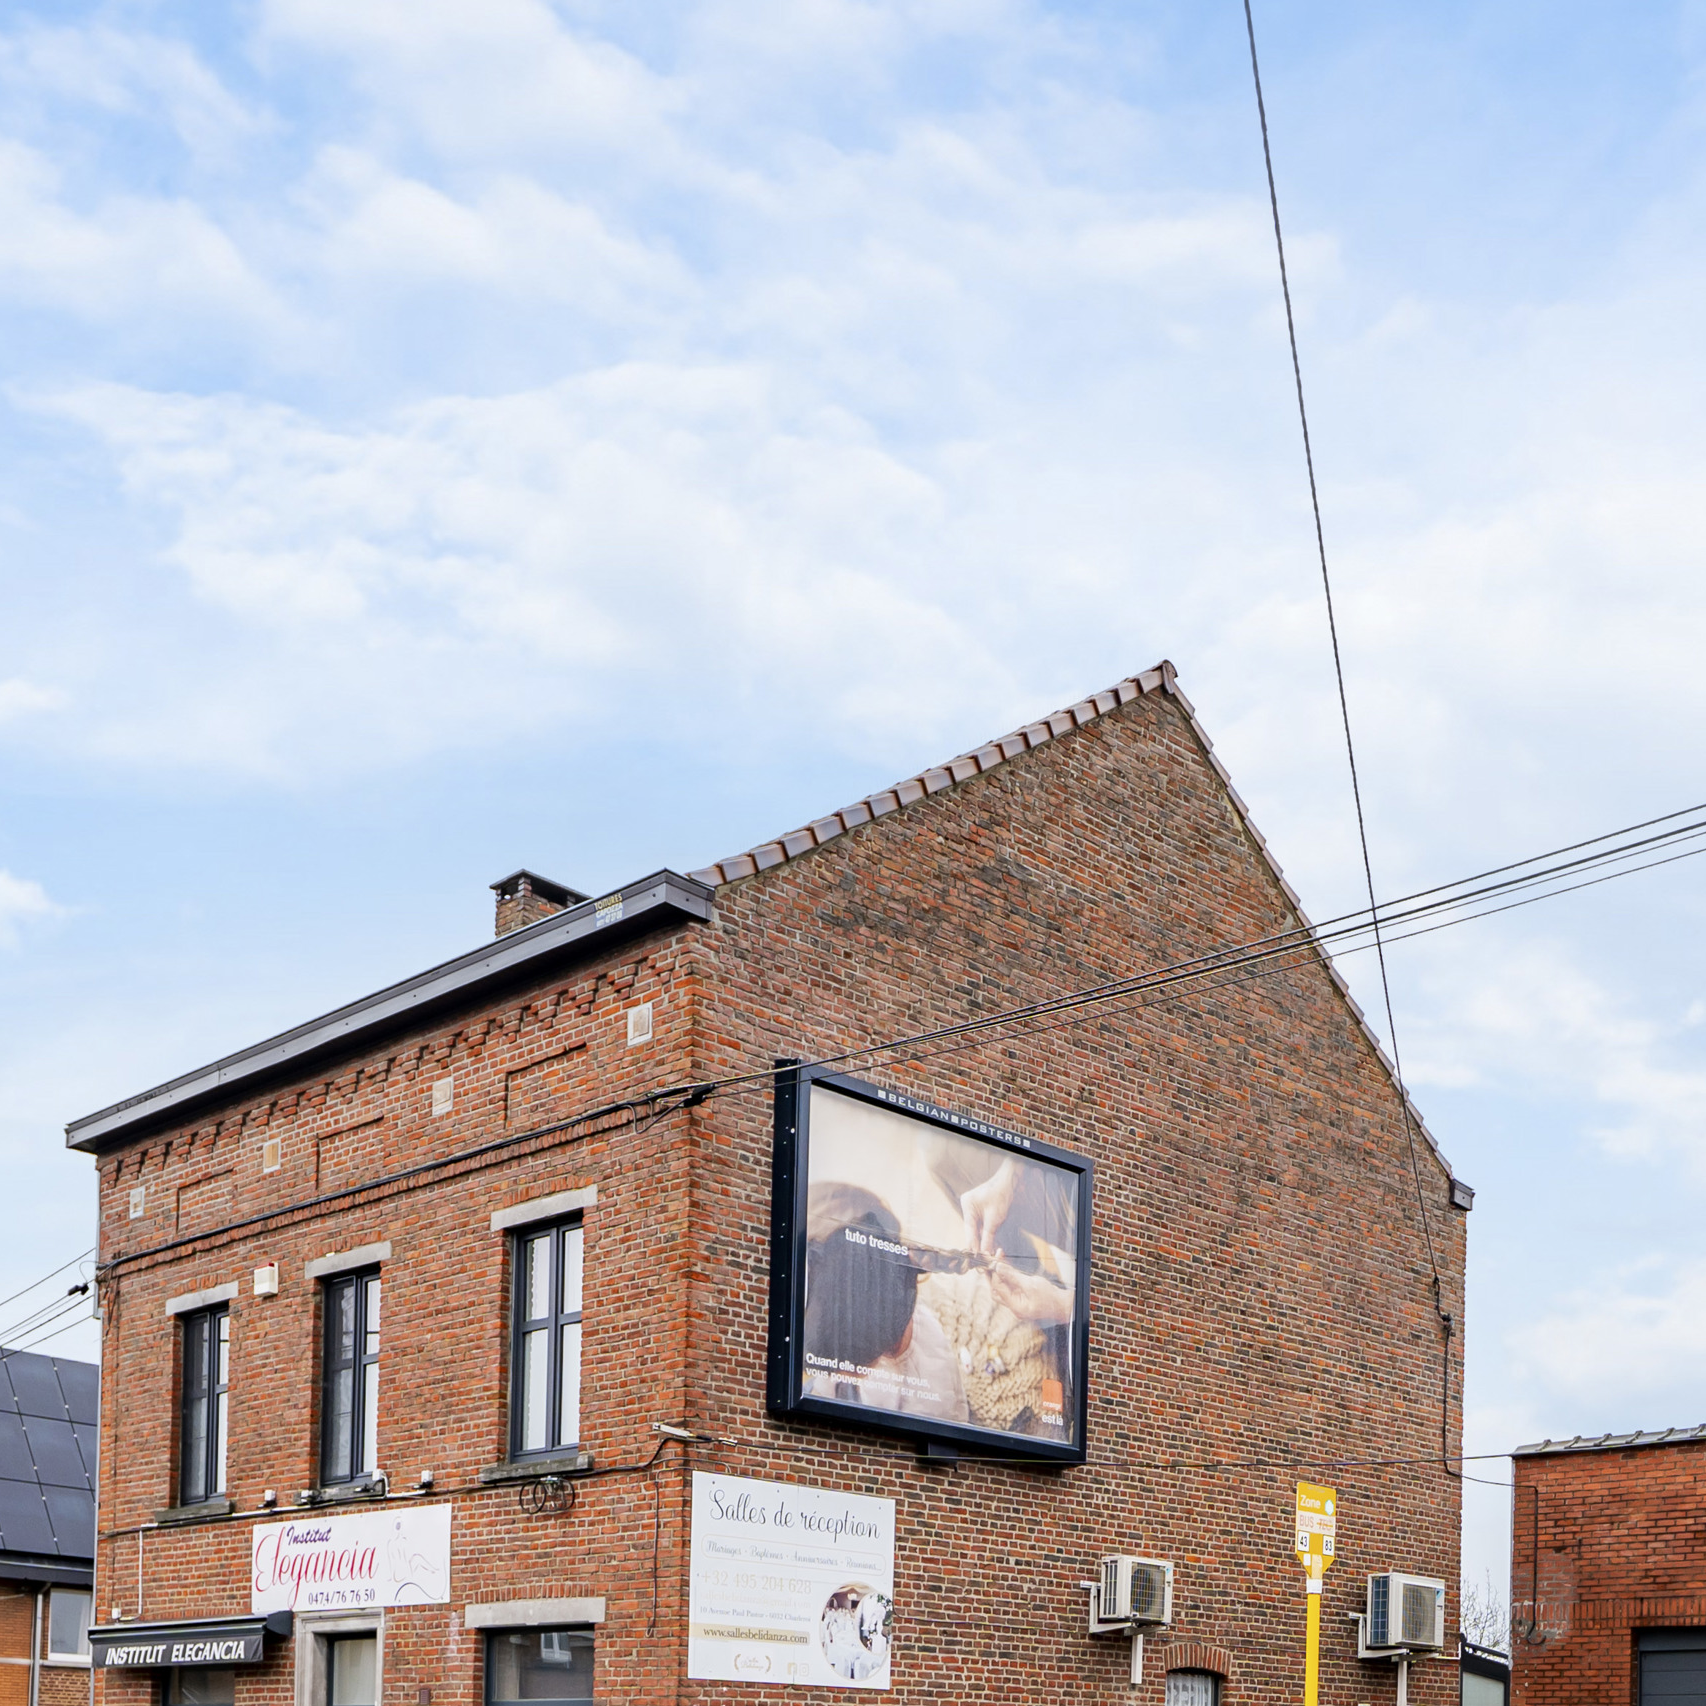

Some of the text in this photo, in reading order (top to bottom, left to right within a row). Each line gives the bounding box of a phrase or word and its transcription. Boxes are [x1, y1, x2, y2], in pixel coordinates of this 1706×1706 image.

[888, 1093, 1022, 1146] BELGIAN POSTERS
[845, 1228, 909, 1256] tuto tresses
[805, 1353, 838, 1369] Quand
[839, 1360, 855, 1372] elle
[856, 1365, 891, 1379] compte
[892, 1373, 904, 1383] sur
[806, 1368, 829, 1379] vous
[830, 1373, 861, 1387] pouvez
[901, 1386, 915, 1397] sur
[1042, 1414, 1055, 1424] est
[1300, 1495, 1321, 1509] Zone
[709, 1489, 881, 1543] Salles de réception
[1299, 1514, 1314, 1528] BUS
[286, 1526, 333, 1546] Institut
[1299, 1536, 1308, 1548] 43
[1325, 1540, 1333, 1551] 83
[707, 1541, 741, 1557] Mariages
[255, 1526, 380, 1611] Elegancia
[701, 1570, 812, 1594] +32 495 204 628
[308, 1588, 376, 1606] 0474/76 76 50
[703, 1627, 809, 1644] www.sallesbelidanza.com
[105, 1641, 245, 1665] INSTITUT ELEGANCIA
